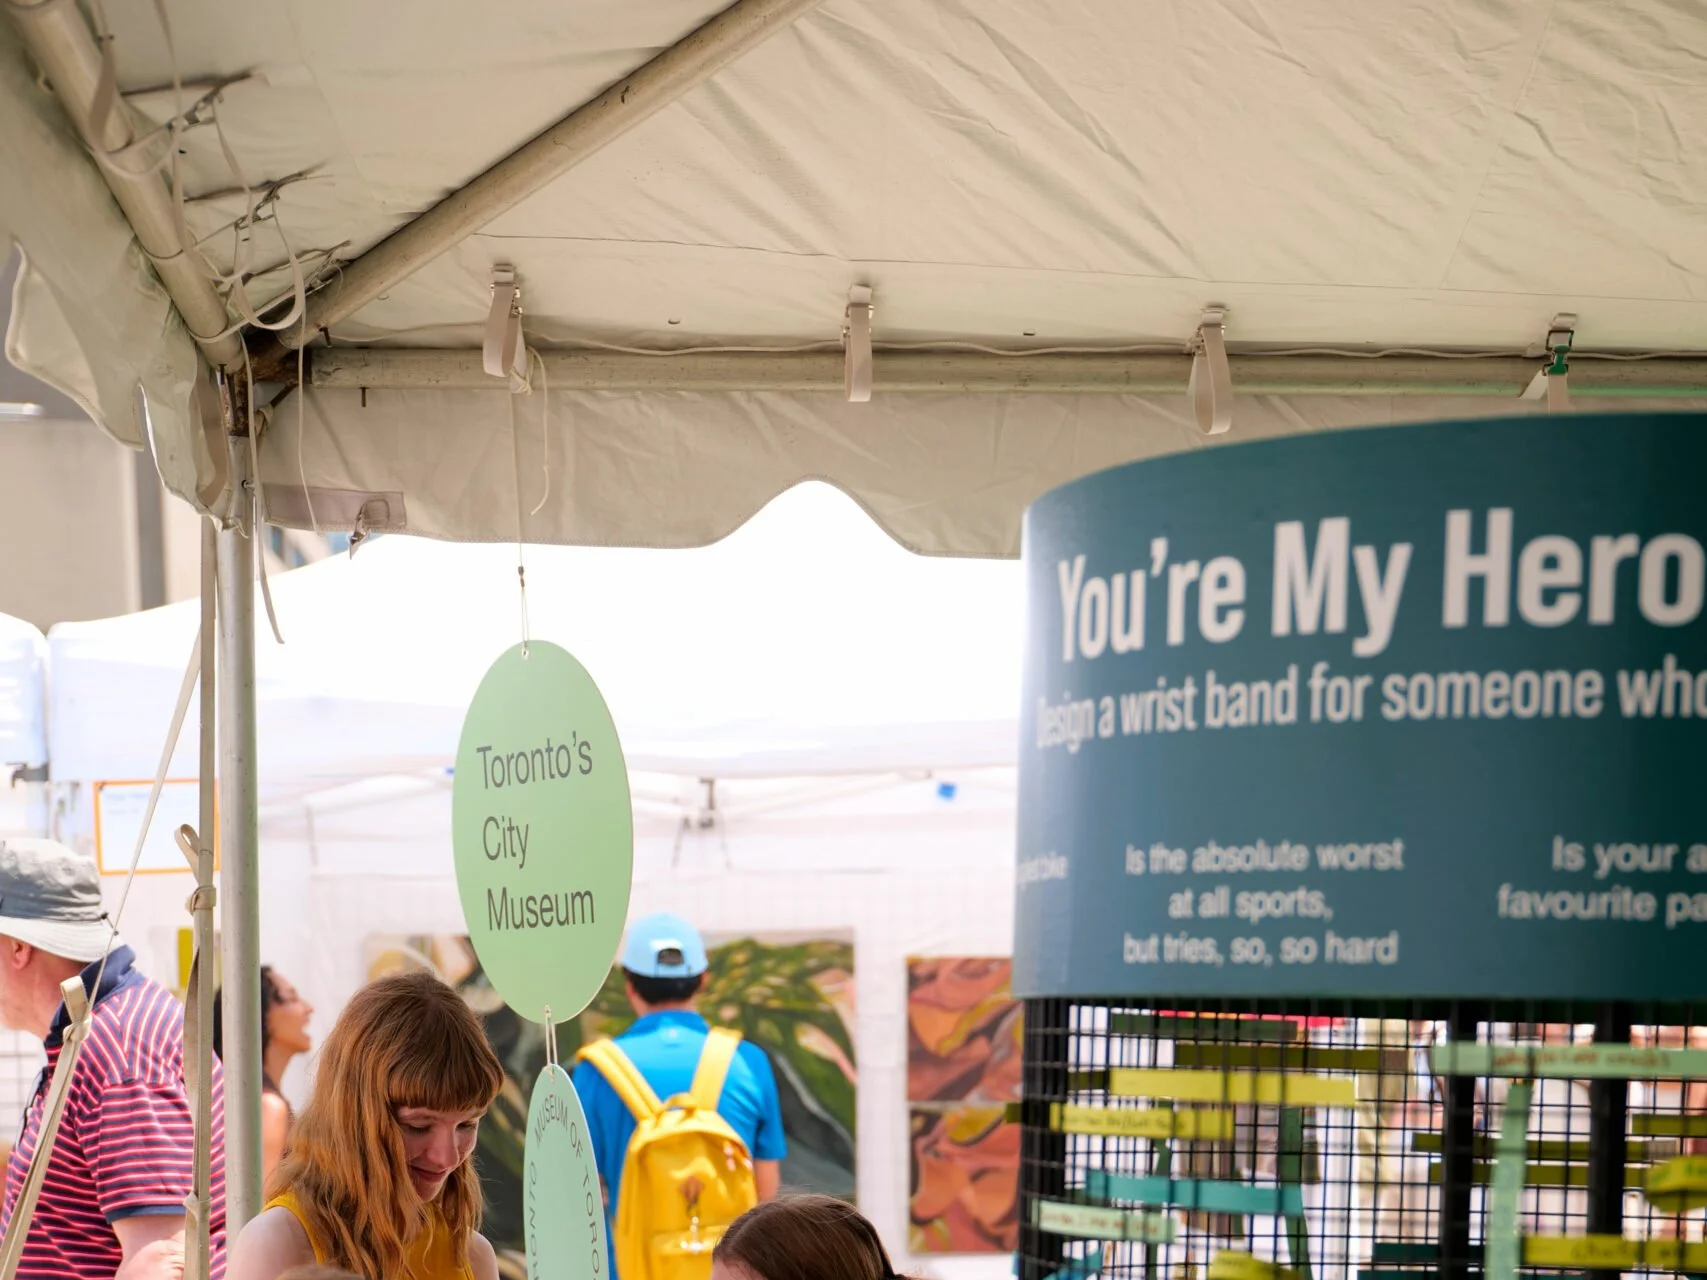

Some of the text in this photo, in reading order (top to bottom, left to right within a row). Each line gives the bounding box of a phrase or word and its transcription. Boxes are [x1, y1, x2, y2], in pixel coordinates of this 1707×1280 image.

[1057, 507, 1706, 663] You're My Hero
[1098, 694, 1116, 739] a
[1120, 675, 1198, 737] wrist
[1204, 663, 1298, 730] band
[1307, 661, 1374, 724] for
[1380, 668, 1605, 721] someone
[476, 730, 593, 790] Toronto's
[482, 814, 530, 870] City
[1125, 837, 1405, 876] Is the absolute worst
[1552, 834, 1586, 872] Is
[1593, 842, 1680, 880] your
[487, 886, 595, 932] Museum
[1168, 884, 1333, 926] at all sports,
[1497, 882, 1659, 921] favourite
[1122, 928, 1399, 968] but tries, so, so hard
[534, 1094, 569, 1150] MUSEUM
[570, 1121, 584, 1159] OF
